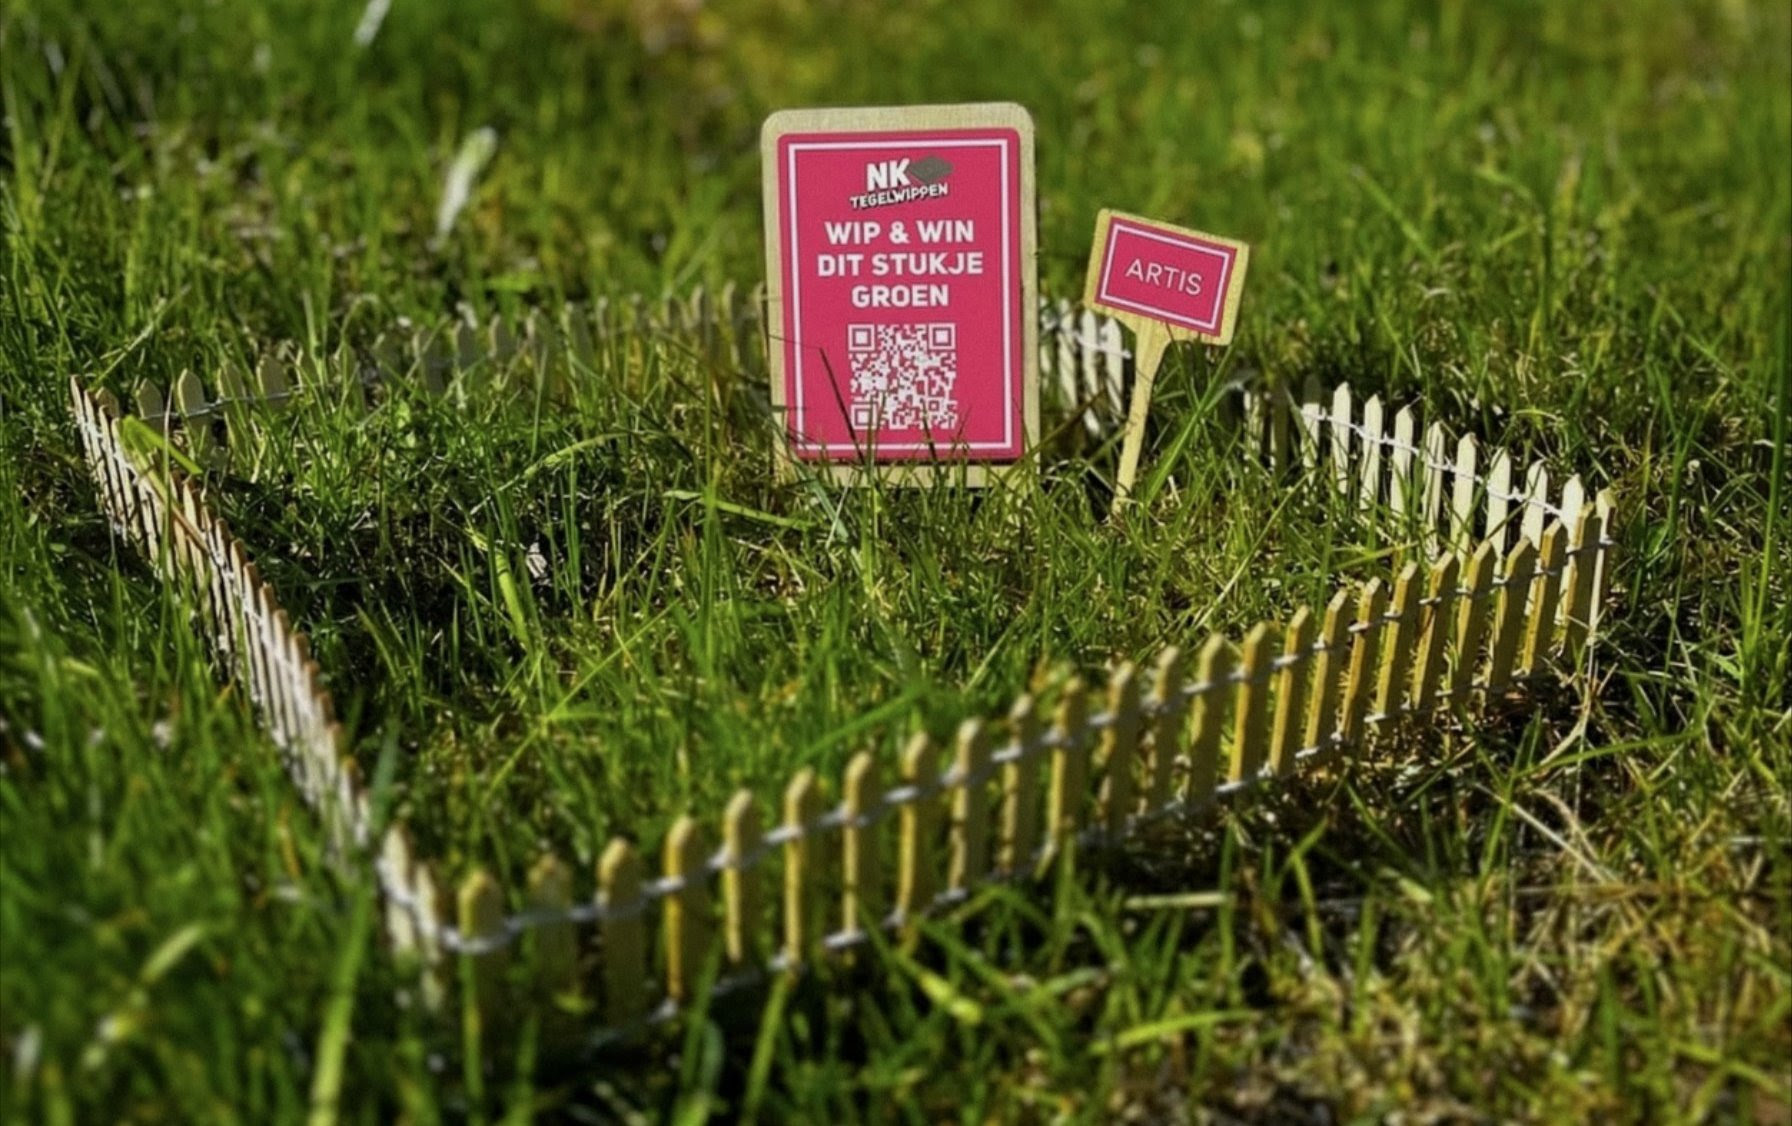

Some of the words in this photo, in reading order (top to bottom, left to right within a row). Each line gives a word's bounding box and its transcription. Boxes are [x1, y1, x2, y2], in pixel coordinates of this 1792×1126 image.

[867, 158, 911, 191] NK
[849, 182, 948, 209] TEGELWIPPEN
[824, 221, 881, 244] WIP
[889, 221, 910, 244] &
[916, 220, 974, 242] WIN
[818, 254, 864, 276] DIT
[871, 252, 984, 275] STUKJE
[1125, 258, 1203, 295] ARTIS
[852, 284, 949, 308] GROEN
